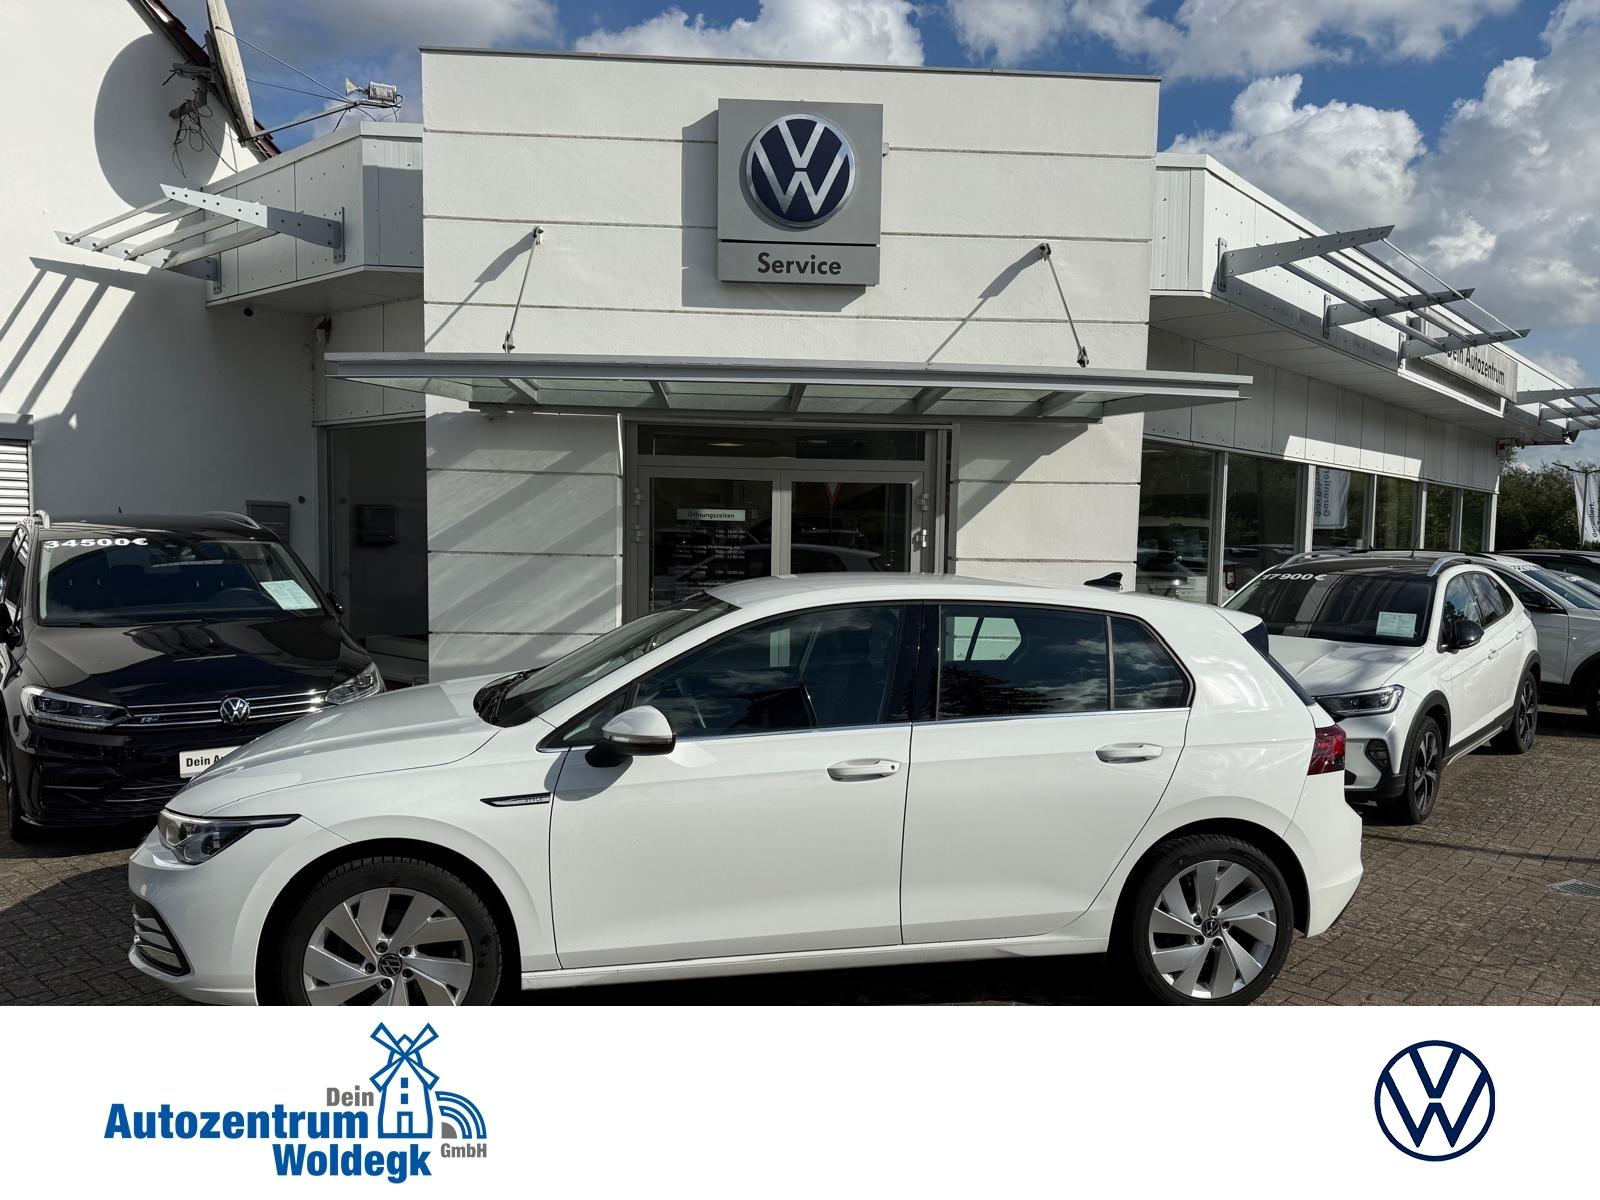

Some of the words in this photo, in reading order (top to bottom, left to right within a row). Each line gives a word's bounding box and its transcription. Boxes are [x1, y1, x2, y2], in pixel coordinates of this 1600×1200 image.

[749, 116, 851, 217] VW
[757, 252, 842, 275] Service
[1465, 347, 1505, 386] Autozentrum
[688, 511, 735, 520] Öffnungszeiten
[43, 537, 149, 550] 34500€
[186, 757, 211, 768] Dein
